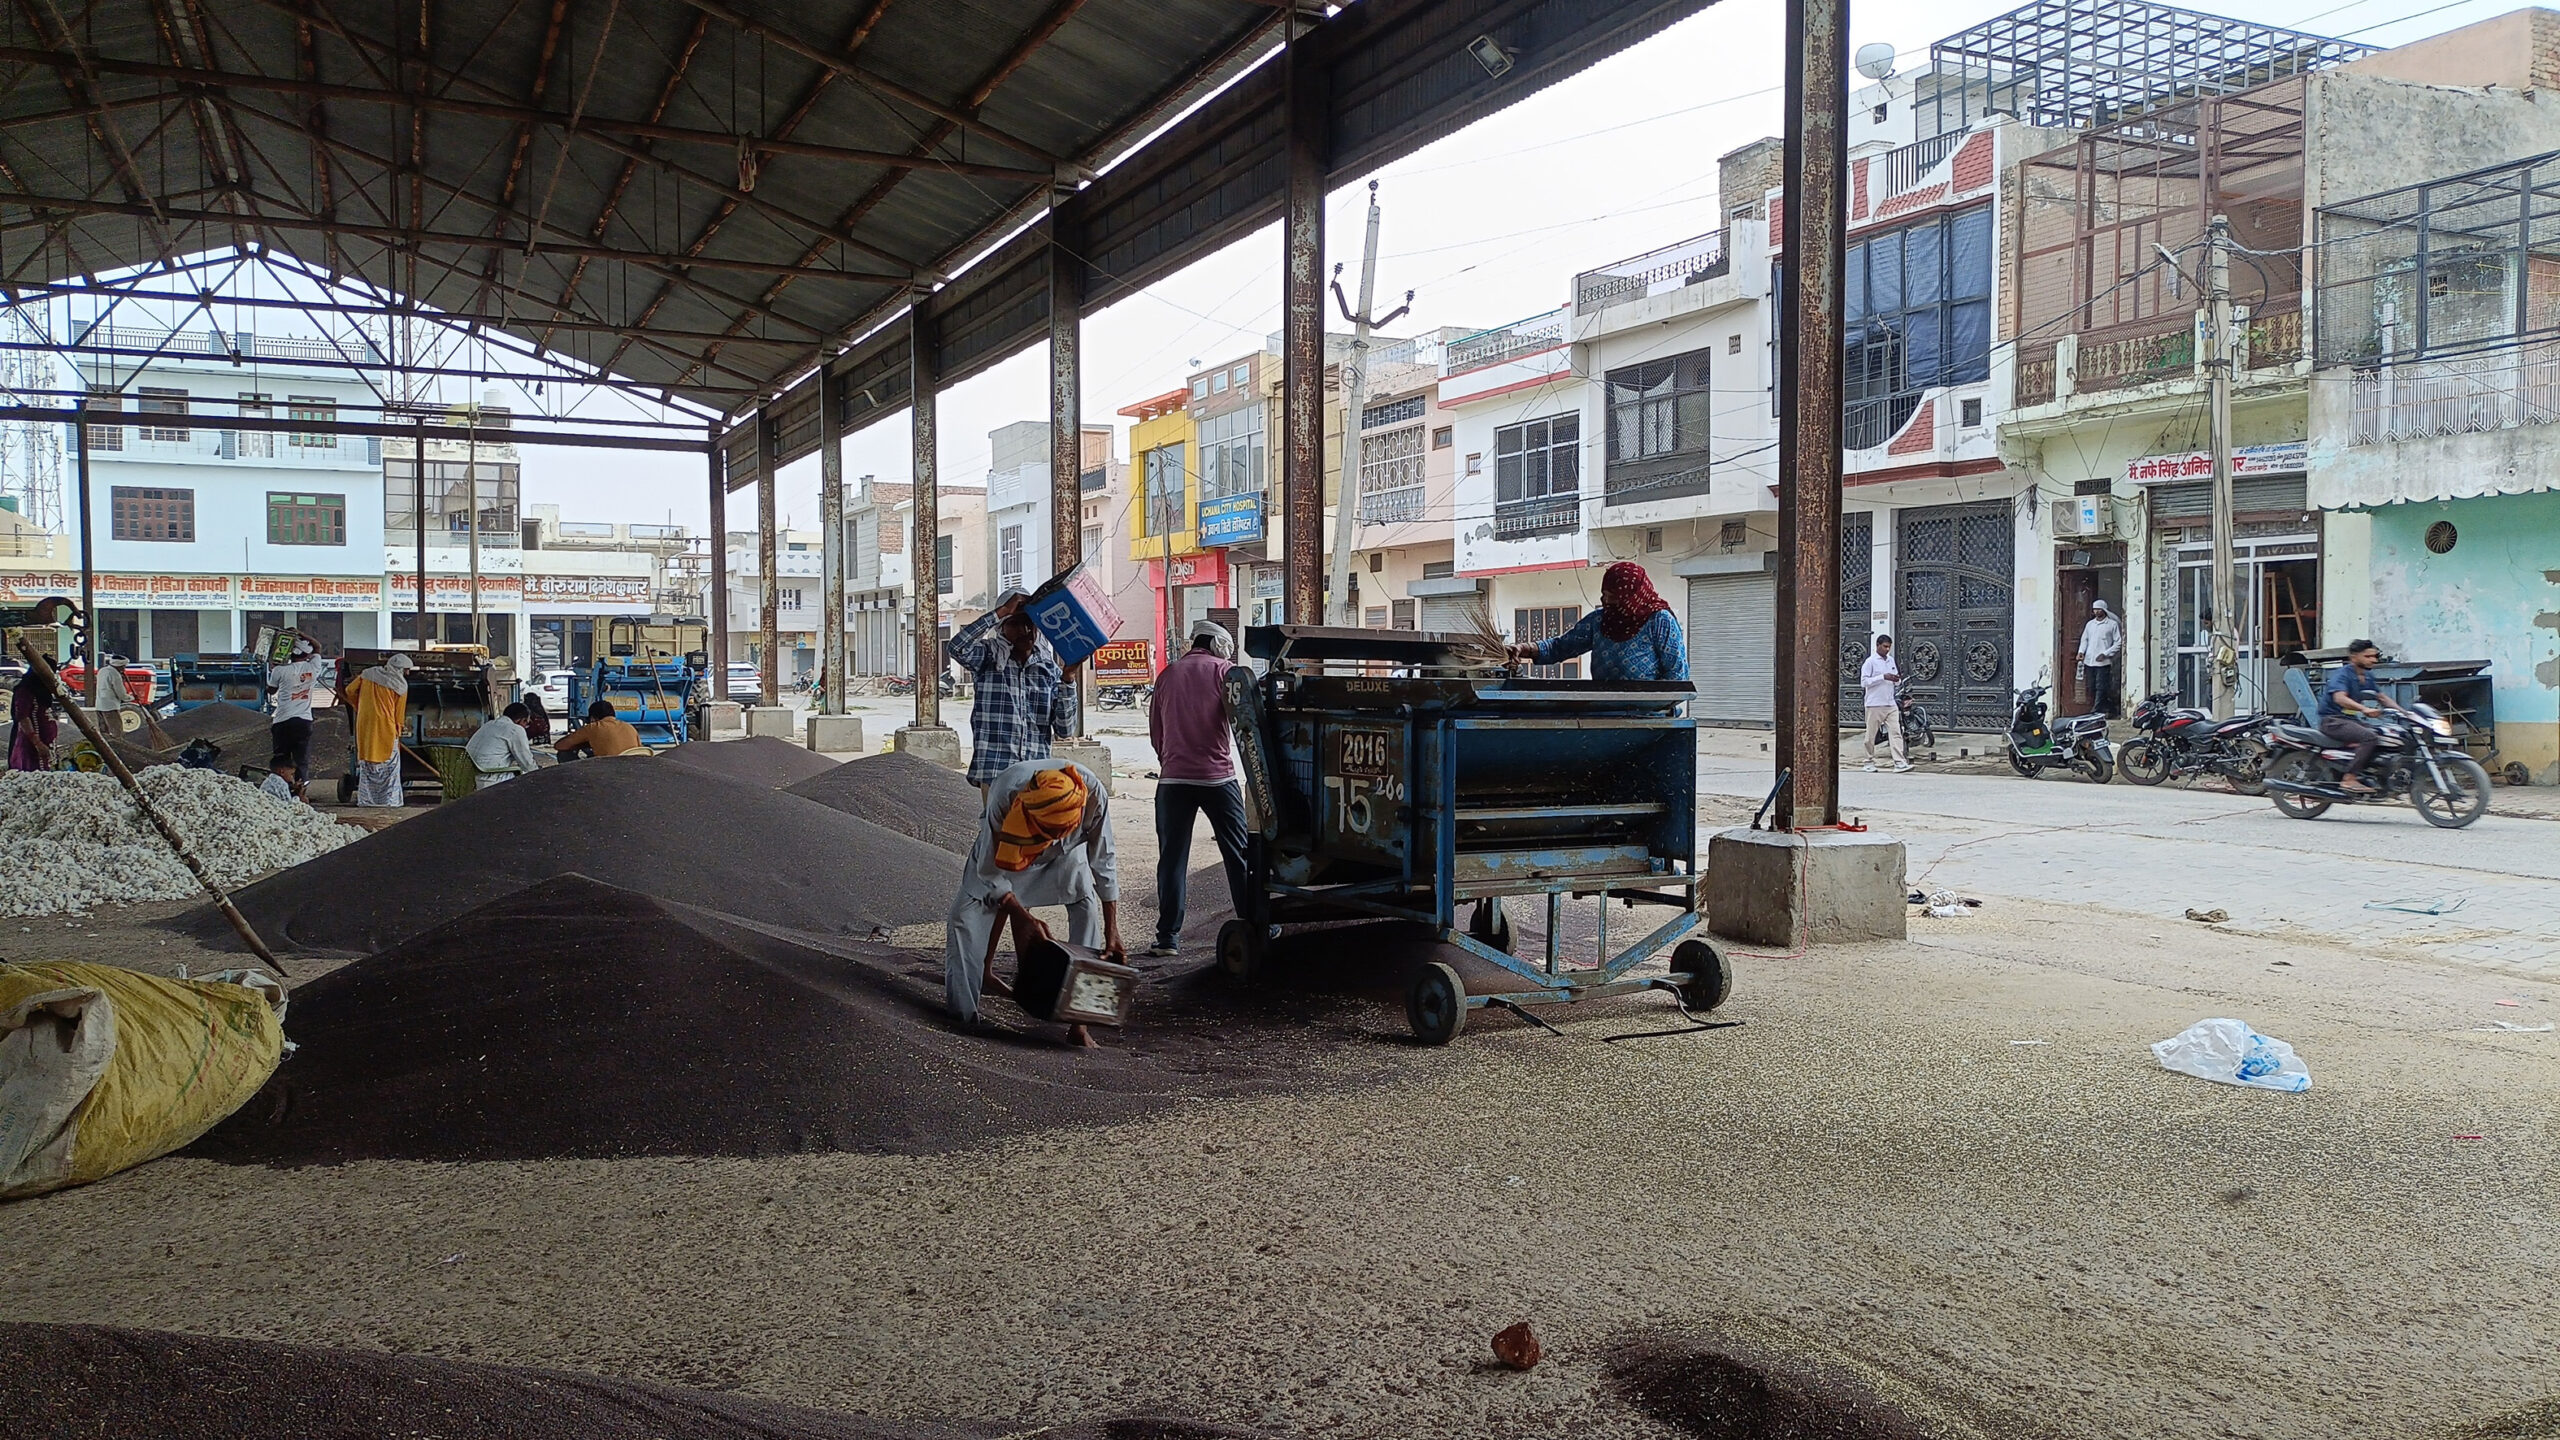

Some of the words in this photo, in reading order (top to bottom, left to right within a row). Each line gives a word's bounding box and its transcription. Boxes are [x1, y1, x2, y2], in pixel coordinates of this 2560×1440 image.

[2158, 459, 2180, 478] सिंह
[2180, 456, 2213, 477] अनिल
[1202, 505, 1220, 517] UCHANA
[1221, 502, 1232, 514] CITY
[1233, 499, 1257, 512] HOSPITAL
[0, 573, 47, 589] कुलदीप
[50, 573, 79, 588] सिंह
[104, 575, 148, 591] किसान
[312, 578, 334, 595] सिंह
[437, 577, 461, 591] राम
[461, 575, 505, 593] गुदियाल
[1096, 643, 1146, 665] एकांशी
[1346, 681, 1390, 692] DELUXE
[1343, 734, 1386, 766] 2016
[1324, 776, 1372, 834] 75
